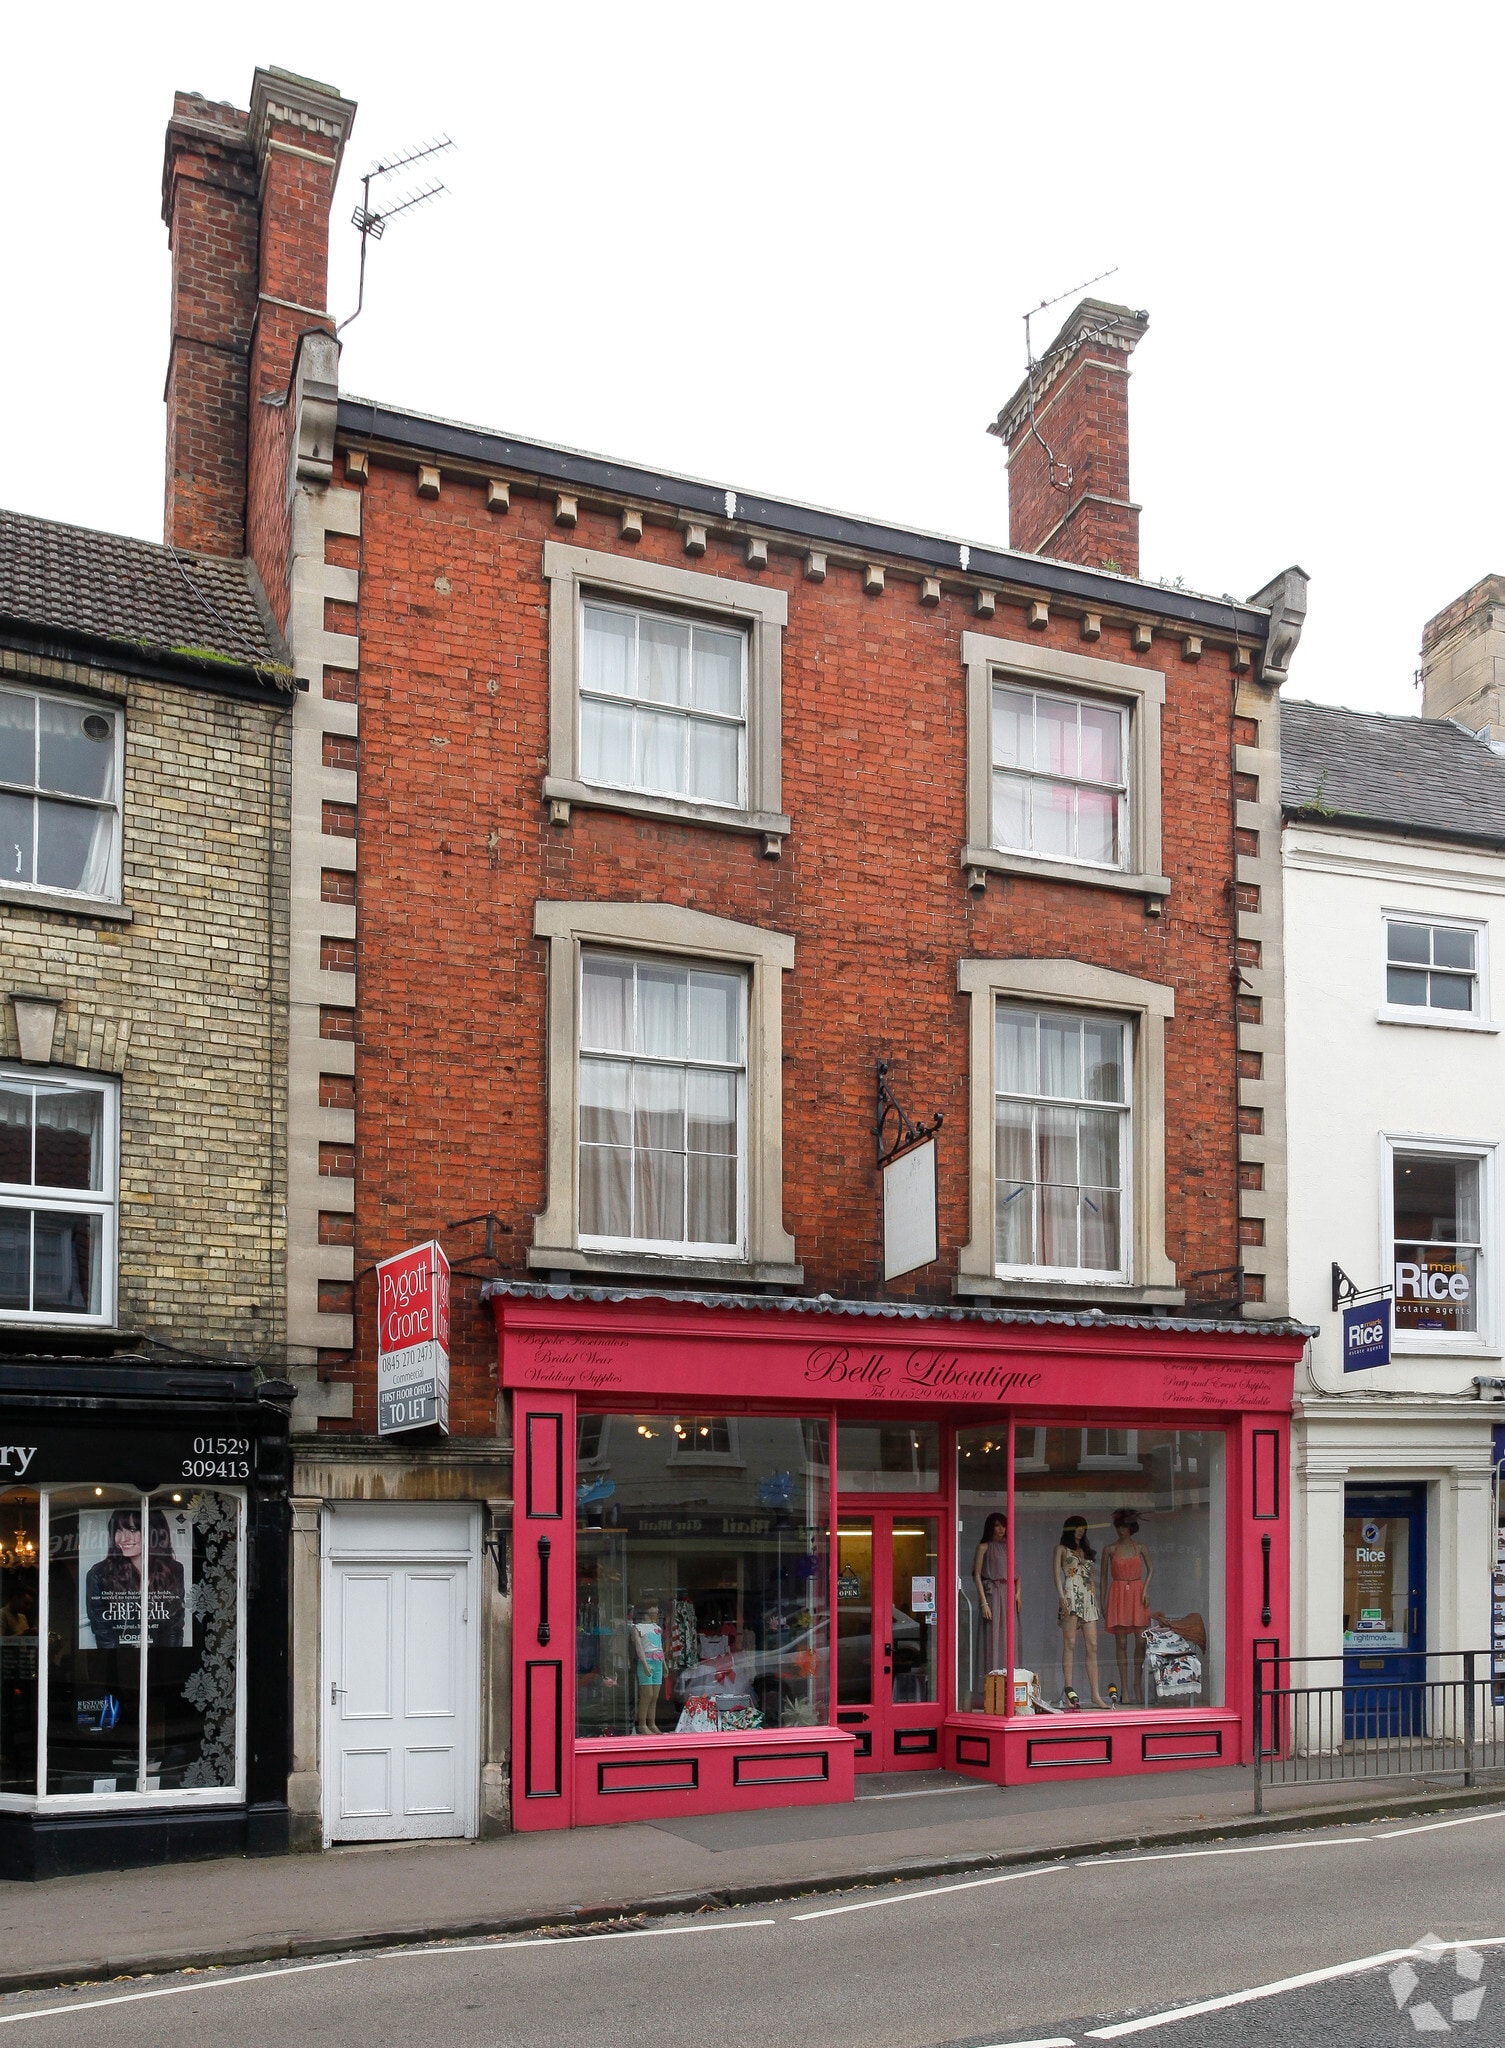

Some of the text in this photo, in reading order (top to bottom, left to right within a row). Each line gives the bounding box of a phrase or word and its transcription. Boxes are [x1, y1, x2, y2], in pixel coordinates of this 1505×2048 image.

[1429, 1262, 1466, 1272] mark
[383, 1261, 428, 1310] Pygott
[1395, 1262, 1470, 1301] Rice
[1395, 1305, 1471, 1316] estate agents
[388, 1307, 429, 1343] Crone
[1364, 1318, 1382, 1327] mark
[517, 1334, 629, 1349] Bespoke Fascinators
[1348, 1323, 1383, 1348] Rice
[382, 1354, 400, 1373] 0845
[403, 1350, 414, 1367] 270
[417, 1344, 433, 1364] 2473
[534, 1350, 613, 1364] Bridal Wear
[1348, 1345, 1384, 1356] estate agents
[392, 1367, 425, 1385] Commercial
[524, 1366, 622, 1387] Wedding Supplies
[804, 1344, 1042, 1400] Belle Liboutique
[382, 1382, 433, 1403] FIRST FLOOR OFFICES
[865, 1384, 983, 1400] Tel. 01529 968300
[1162, 1375, 1271, 1394] Party and Event Supplies
[1162, 1390, 1194, 1403] Private
[1229, 1393, 1271, 1406] Available
[389, 1403, 405, 1424] TO
[408, 1397, 426, 1421] LET
[193, 1437, 249, 1456] 01529
[0, 1446, 38, 1477] ry
[181, 1460, 249, 1479] 309413
[1356, 1547, 1386, 1562] Rice
[102, 1610, 135, 1621] GIRL
